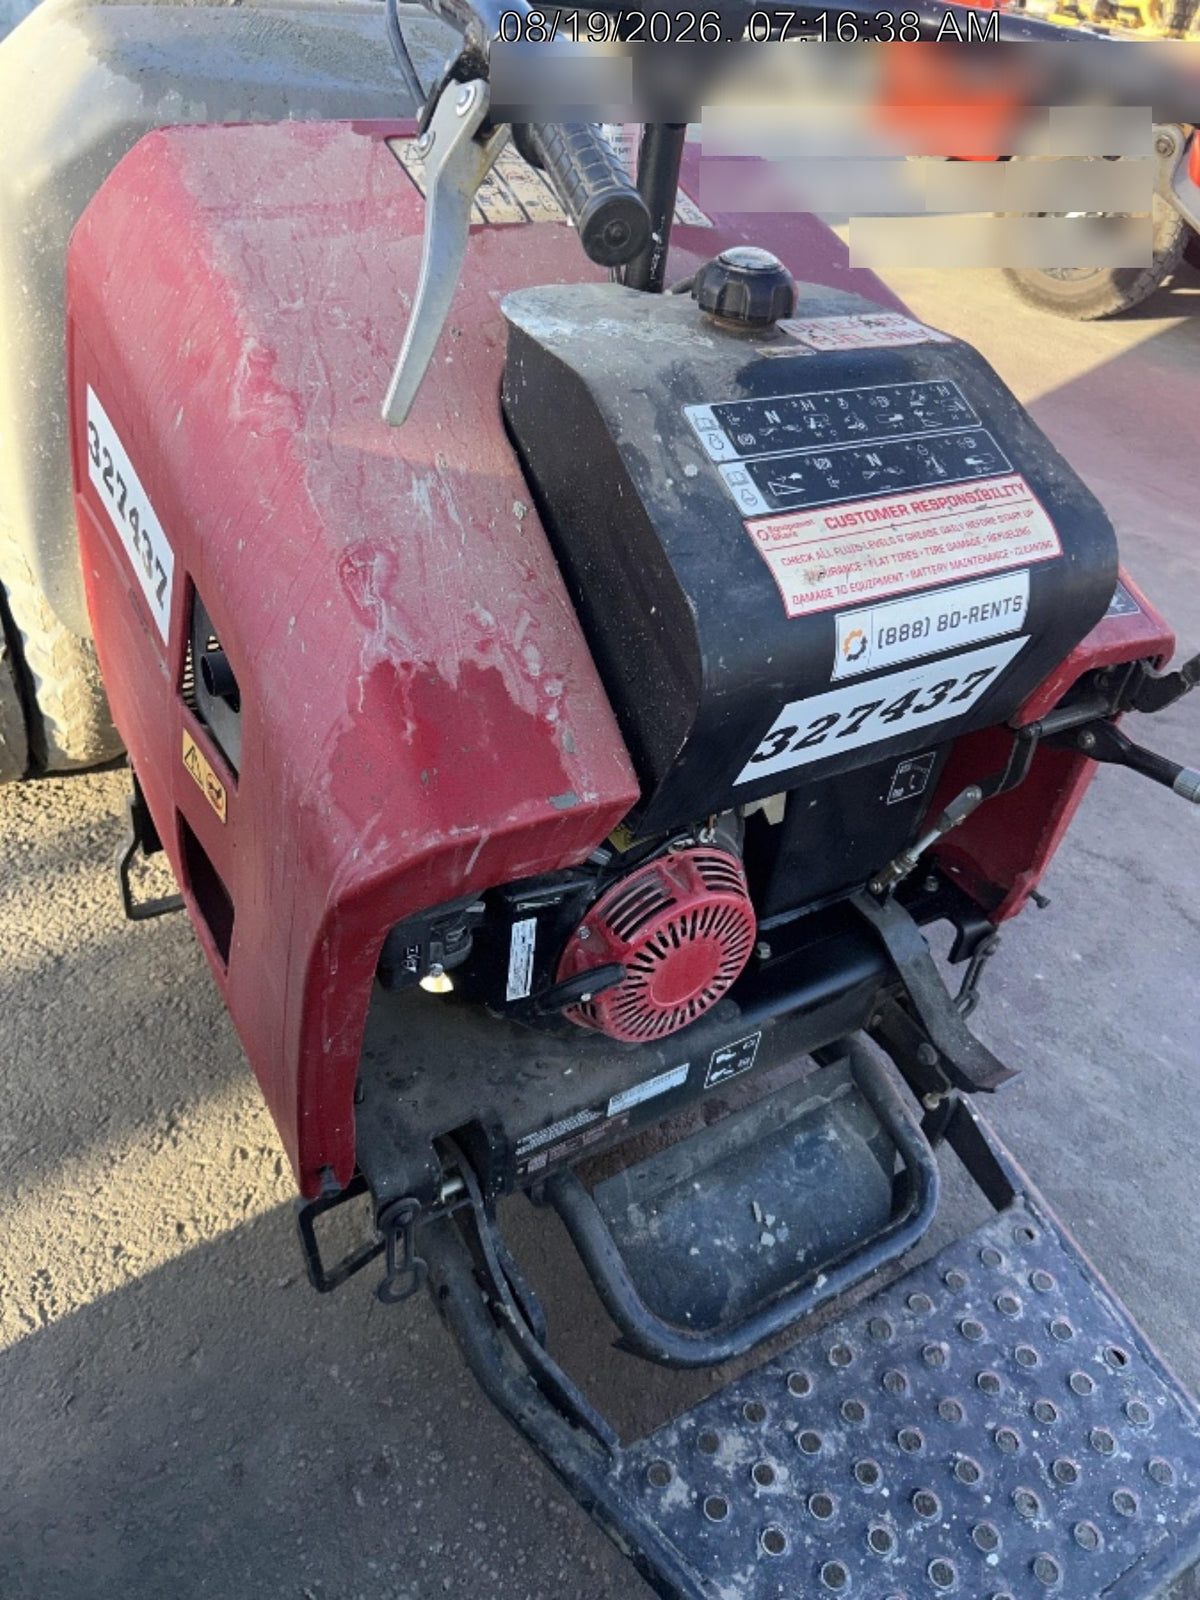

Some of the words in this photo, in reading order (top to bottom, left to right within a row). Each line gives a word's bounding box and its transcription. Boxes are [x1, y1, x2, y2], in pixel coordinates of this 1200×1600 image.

[87, 420, 169, 611] 327437
[824, 504, 909, 530] CUSTOMER
[911, 483, 1025, 513] RESPONSIBILITY
[791, 588, 834, 606] DAMAGE
[834, 584, 848, 595] TO
[849, 573, 905, 594] EQUIPMENT
[910, 563, 949, 580] BATTERY
[948, 549, 1010, 571] MAINTENANCE
[891, 549, 919, 563] TIRES
[923, 544, 946, 557] TIRE
[878, 618, 931, 650] (888)
[748, 666, 999, 764] 327437
